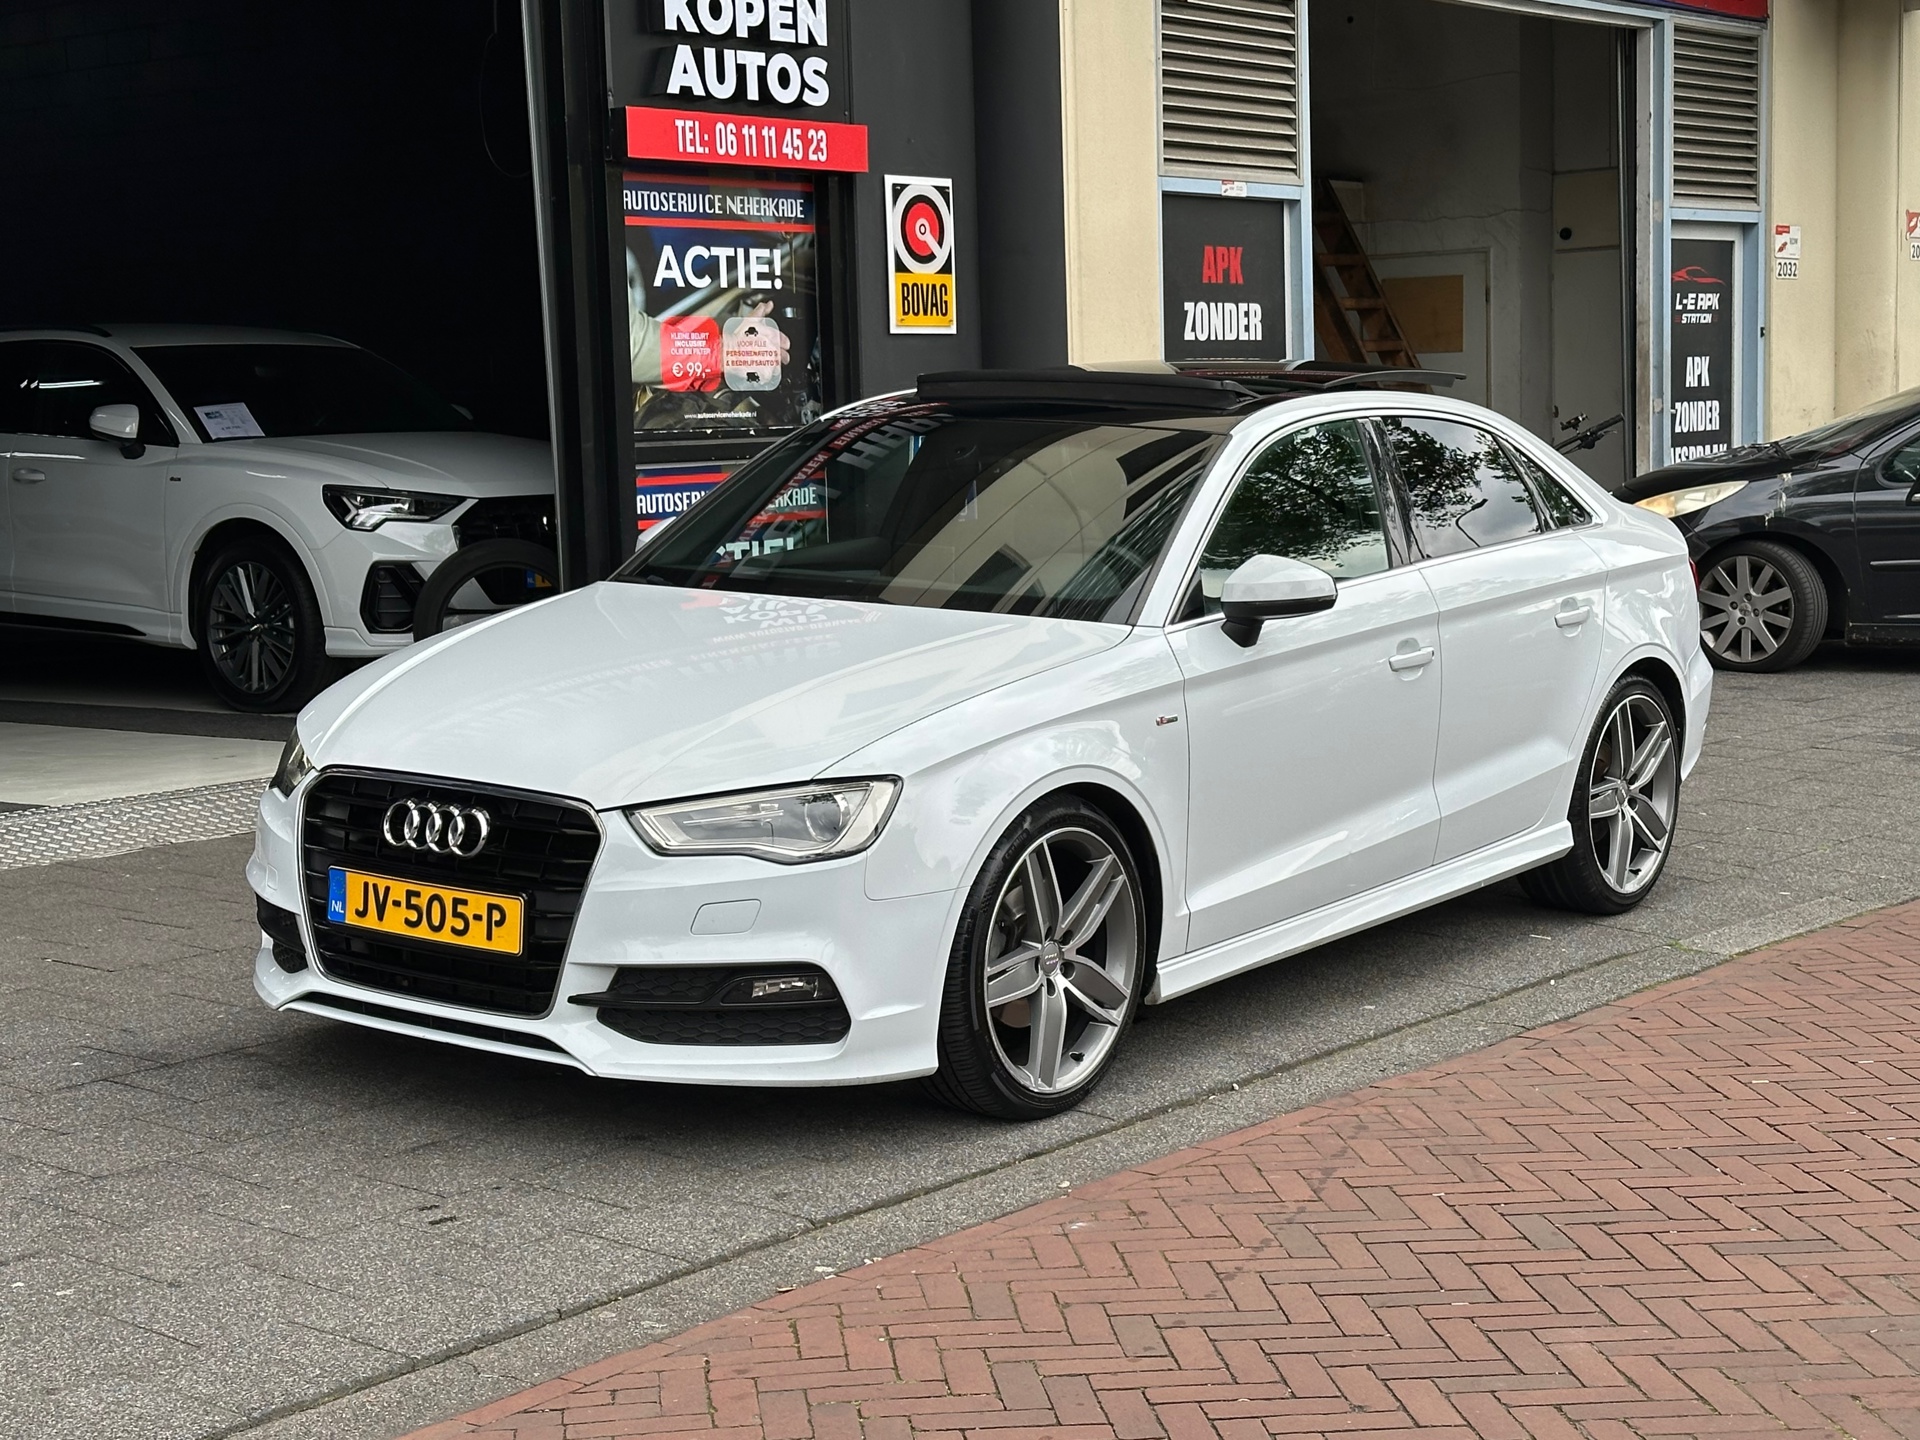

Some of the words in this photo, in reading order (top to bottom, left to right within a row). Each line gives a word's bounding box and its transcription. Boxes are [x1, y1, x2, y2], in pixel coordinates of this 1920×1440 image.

[664, 0, 828, 46] KOPEN
[667, 44, 830, 107] AUTOS
[675, 119, 710, 154] TEL:
[715, 121, 737, 157] 06
[742, 124, 756, 158] 11
[762, 125, 777, 159] 11
[782, 127, 803, 161] 45
[808, 129, 828, 163] 23
[623, 189, 722, 215] AUTOSERVICE
[726, 194, 805, 219] NEHERKADE
[653, 245, 783, 290] ACTIE!
[1202, 245, 1244, 285] APK
[1777, 262, 1797, 277] 2032
[901, 282, 948, 317] BOVAG
[1675, 293, 1697, 310] L-E
[1697, 293, 1721, 310] APK
[1183, 301, 1263, 342] ZONDER
[1681, 313, 1712, 324] STATION
[672, 361, 684, 378] €
[1685, 356, 1710, 388] APK
[1674, 400, 1720, 433] ZONDER
[331, 900, 345, 914] NL
[354, 880, 507, 942] JV-505-P
